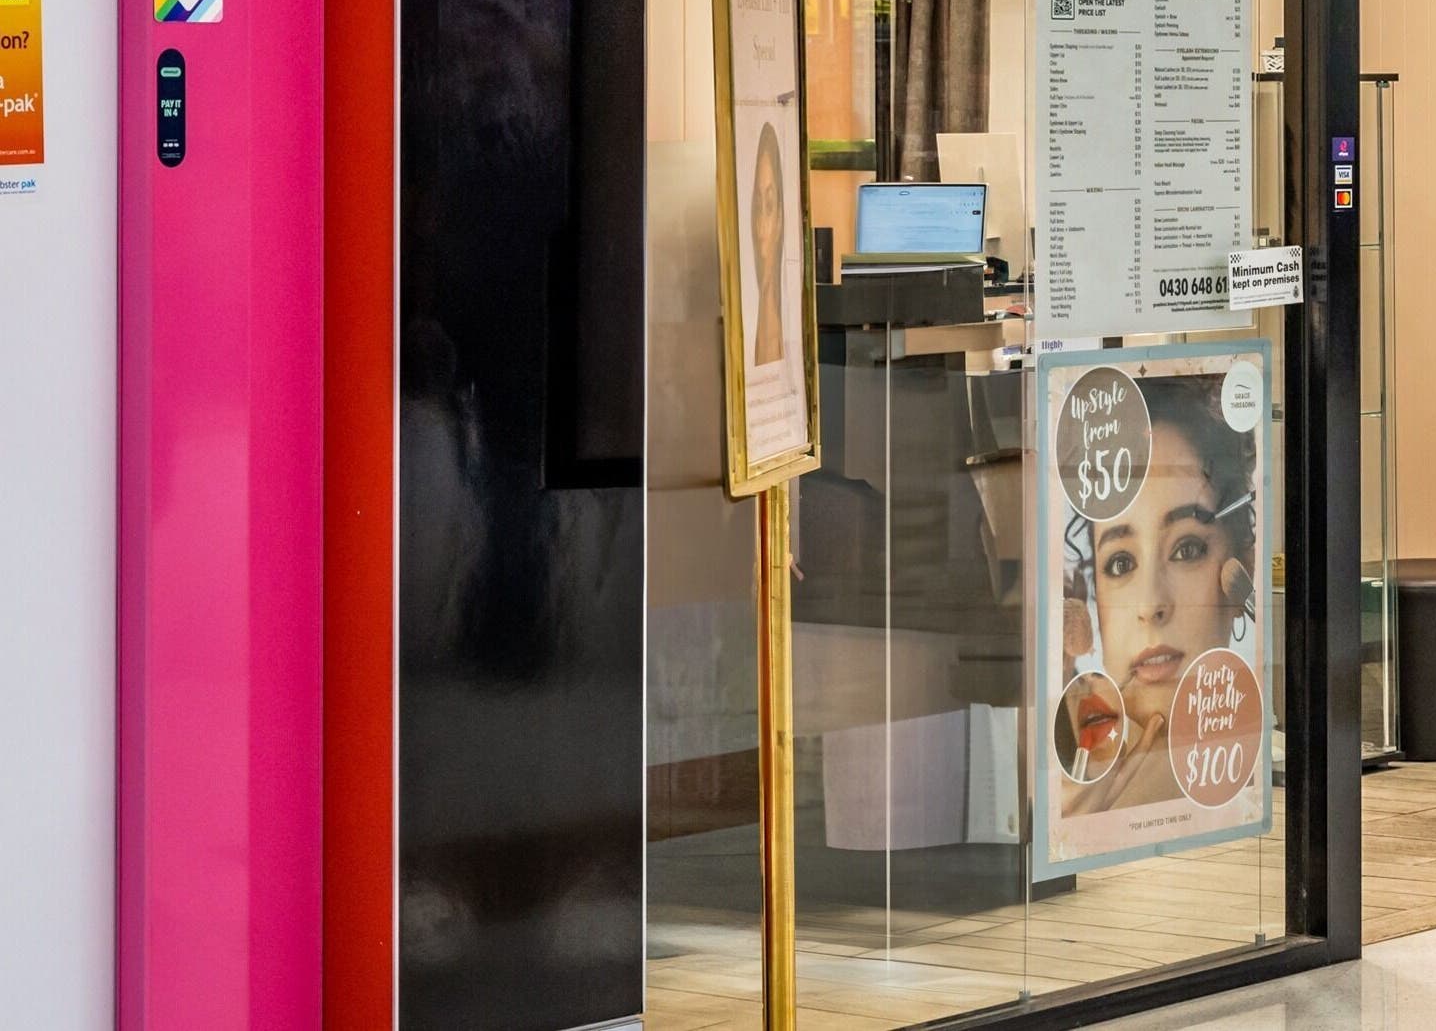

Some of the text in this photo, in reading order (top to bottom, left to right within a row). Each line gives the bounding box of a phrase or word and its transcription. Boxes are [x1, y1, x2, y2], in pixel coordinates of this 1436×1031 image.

[1106, 0, 1125, 7] LATEST
[1095, 9, 1106, 17] LIST
[0, 31, 29, 49] on?
[161, 99, 182, 108] PAY IT
[164, 108, 178, 117] IN 4
[21, 179, 37, 190] pak
[1232, 265, 1274, 278] Minimum
[1276, 260, 1300, 273] Cash
[1159, 275, 1230, 297] 0430 648 61
[1232, 274, 1300, 290] kept on premises
[1083, 419, 1120, 450] from
[1078, 447, 1132, 510] $50
[1196, 664, 1237, 691] Party
[1198, 712, 1235, 740] from
[1186, 741, 1244, 792] $100
